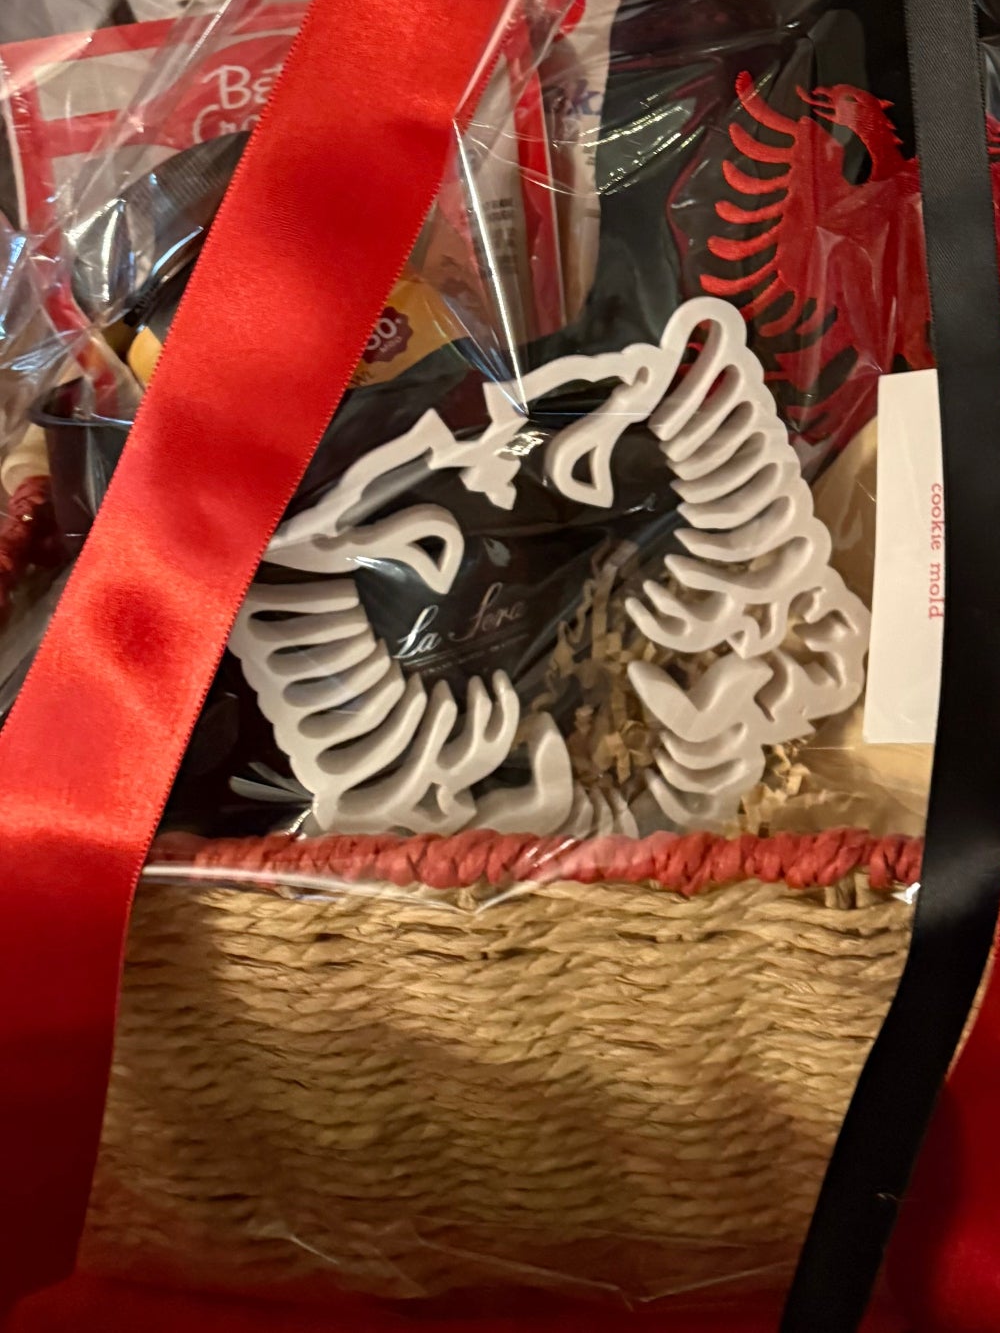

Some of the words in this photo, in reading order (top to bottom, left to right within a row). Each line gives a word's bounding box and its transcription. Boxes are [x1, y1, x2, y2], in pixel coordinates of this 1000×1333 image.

[930, 482, 945, 551] cookie
[928, 562, 945, 621] mold
[391, 604, 442, 660] La
